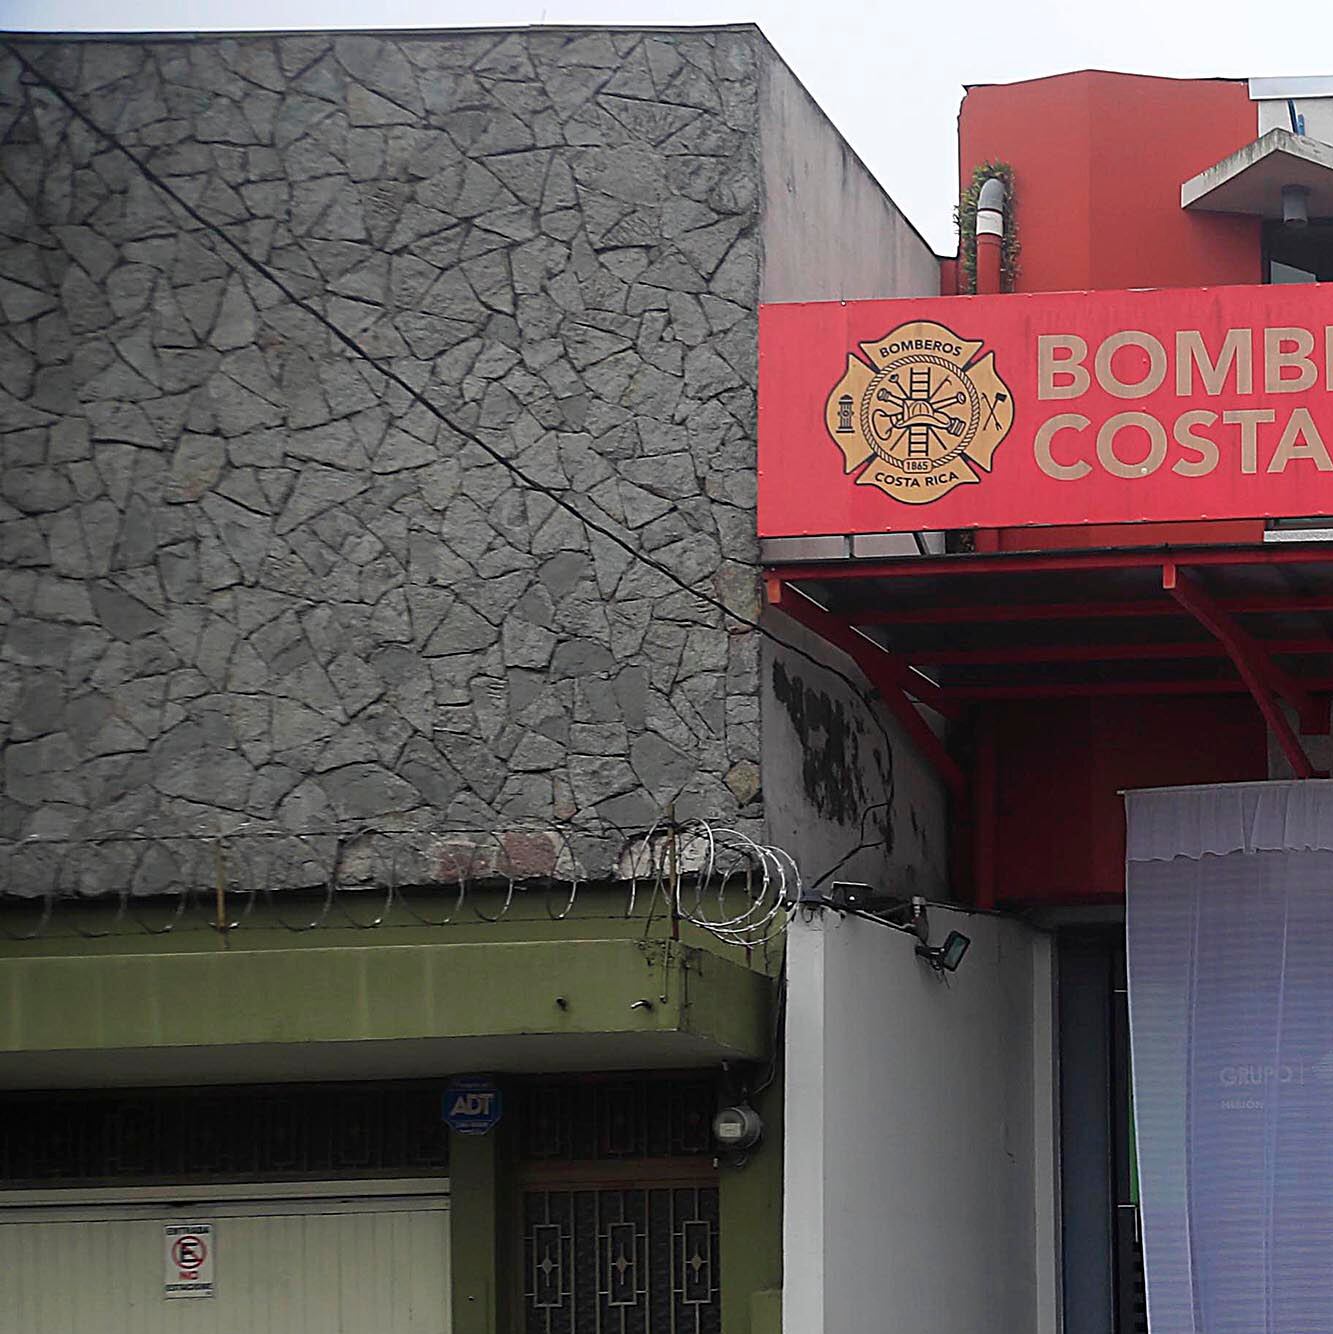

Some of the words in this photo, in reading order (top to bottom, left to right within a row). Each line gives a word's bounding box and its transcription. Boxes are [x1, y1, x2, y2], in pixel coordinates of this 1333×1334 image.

[879, 339, 963, 359] BOMBEROS
[905, 460, 929, 471] 1865
[874, 471, 921, 488] COSTA
[925, 471, 960, 487] RICA
[1219, 1063, 1294, 1087] GRUPO
[449, 1093, 495, 1116] ADT
[179, 1270, 199, 1280] NO
